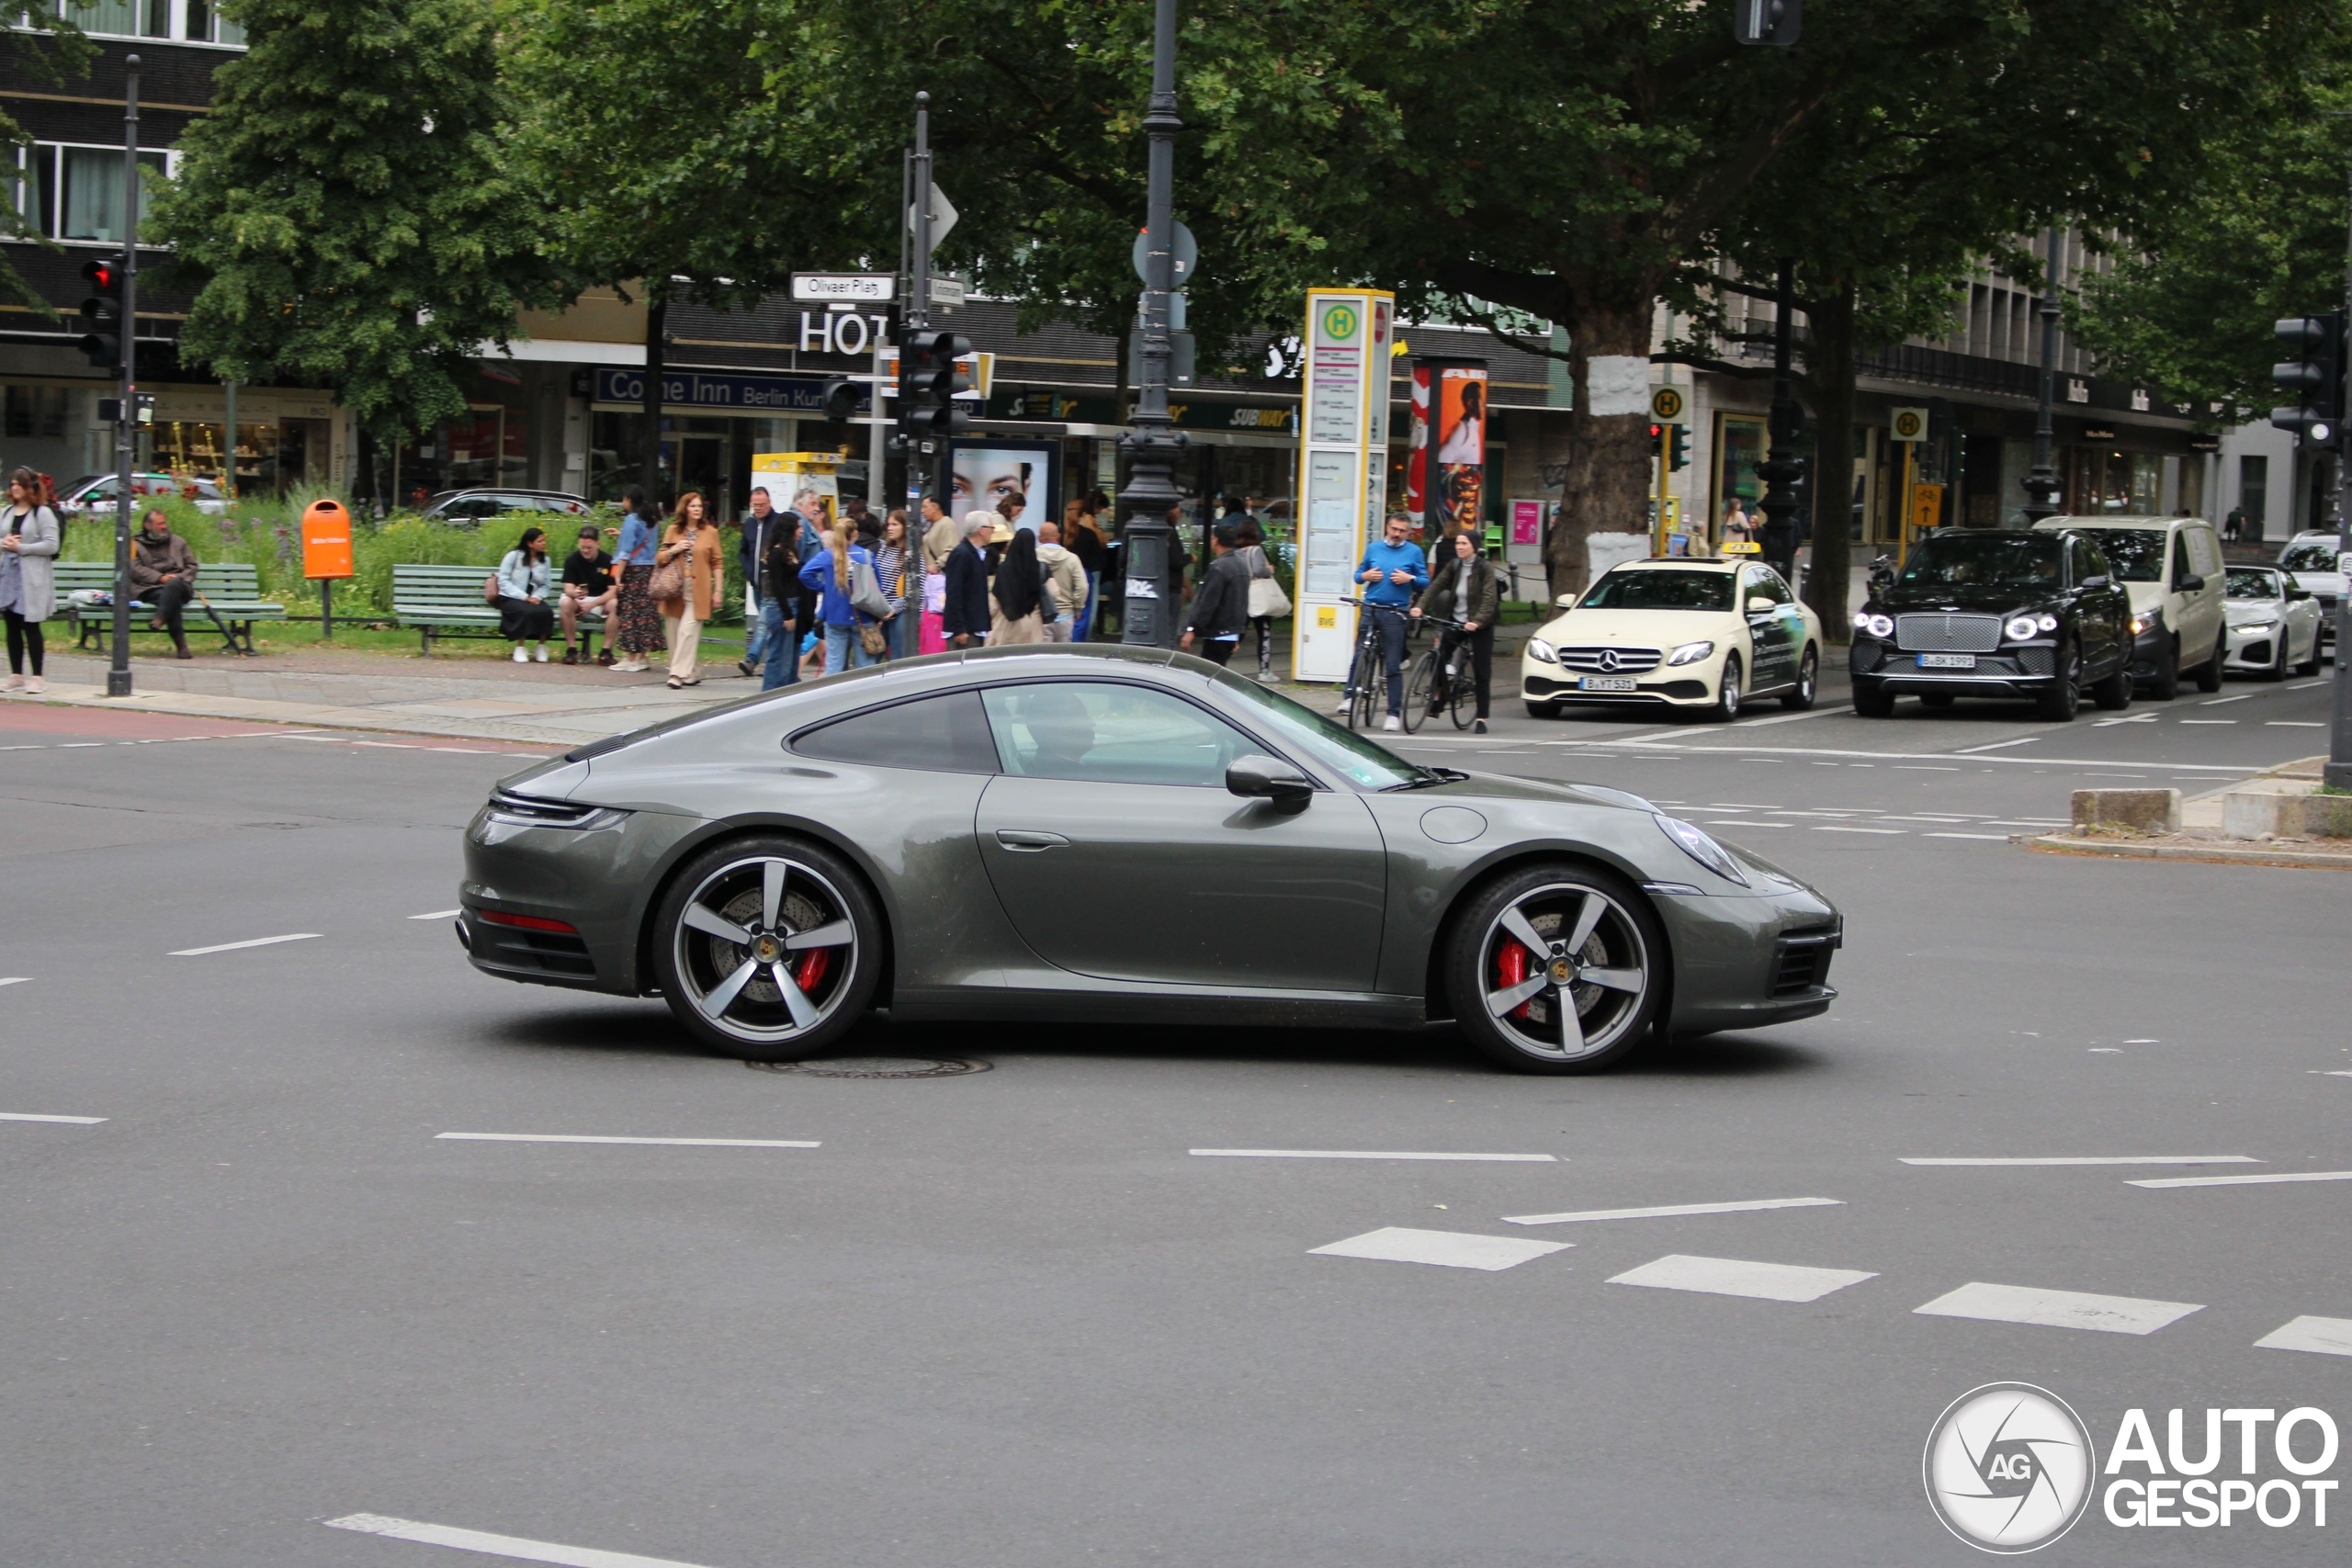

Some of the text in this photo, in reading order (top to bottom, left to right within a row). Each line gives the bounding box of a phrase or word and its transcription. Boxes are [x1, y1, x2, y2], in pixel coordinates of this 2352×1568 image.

[808, 278, 851, 293] Olivaer
[610, 372, 684, 401] Coe
[692, 376, 730, 402] Inn
[743, 387, 788, 406] Berlin
[1229, 408, 1292, 427] SUBWAY
